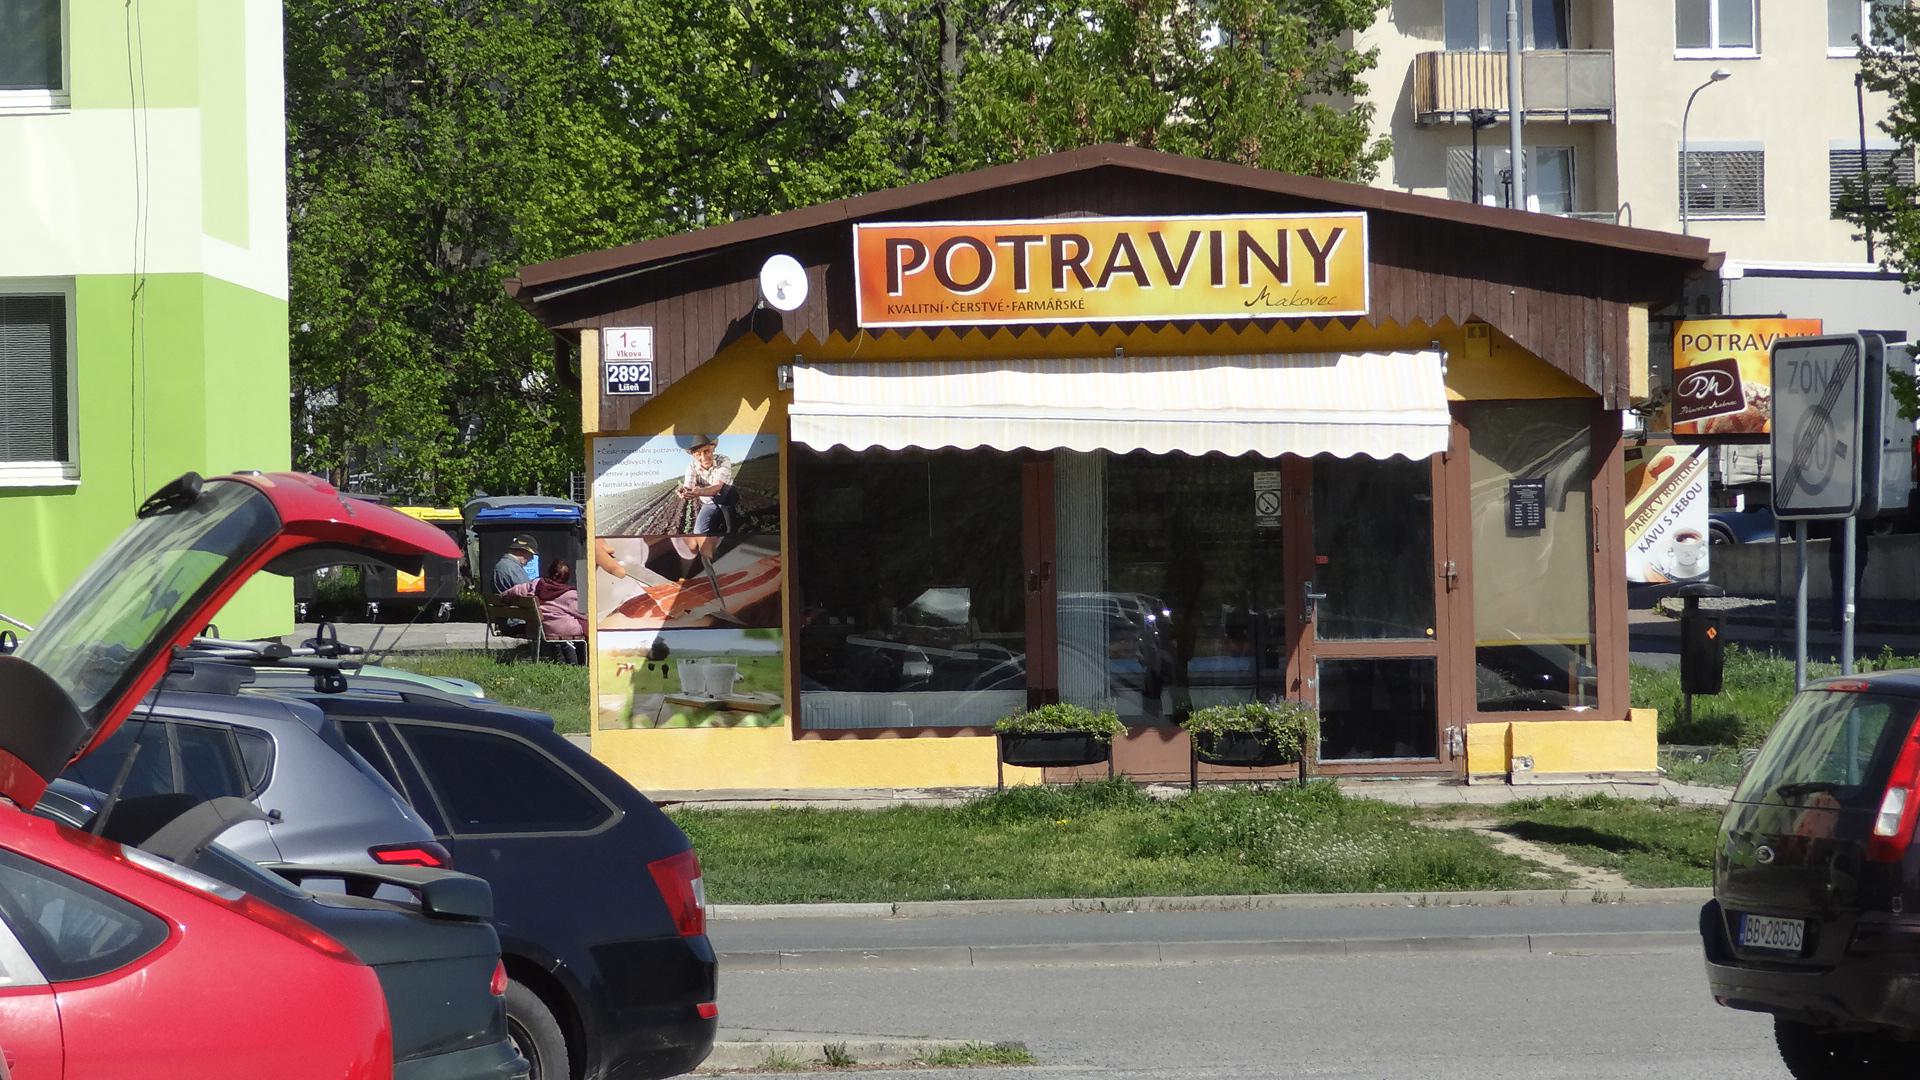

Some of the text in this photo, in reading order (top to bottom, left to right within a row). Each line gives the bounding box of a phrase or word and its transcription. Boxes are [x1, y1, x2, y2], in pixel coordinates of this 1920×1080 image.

[885, 227, 1347, 296] POTRAVINY
[1011, 297, 1085, 312] FARMÁŘSKÉ
[1244, 285, 1337, 307] Makovec
[1681, 332, 1815, 352] POTRAV
[608, 365, 650, 382] 2892
[1638, 482, 1703, 554] KÁVU S SEBOU
